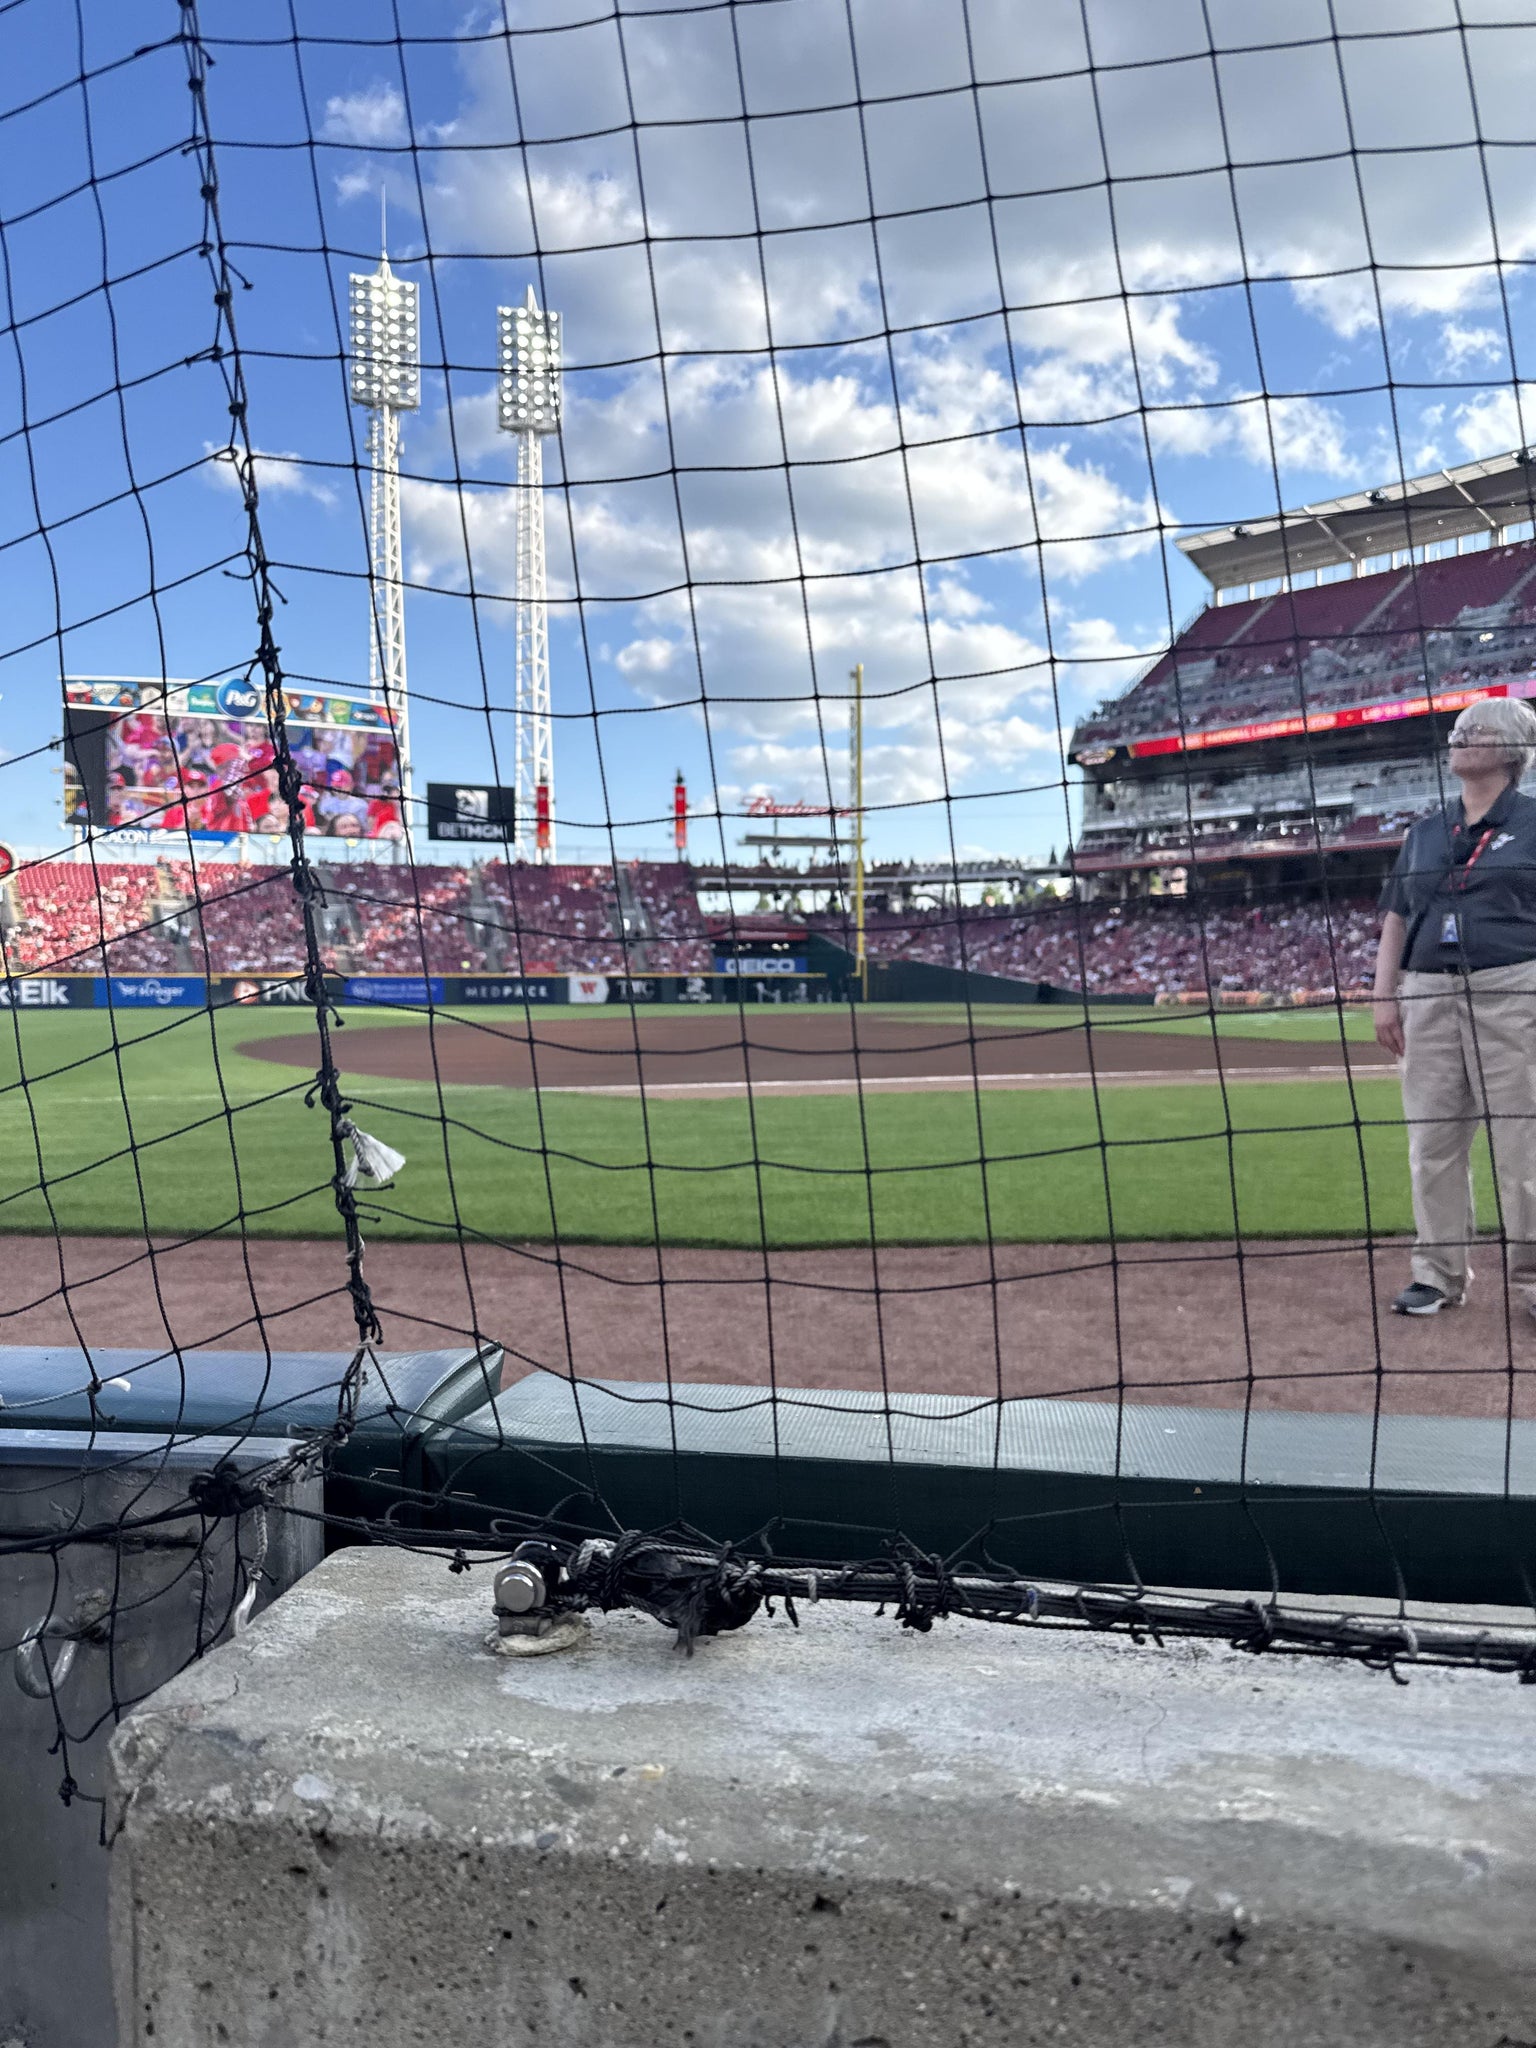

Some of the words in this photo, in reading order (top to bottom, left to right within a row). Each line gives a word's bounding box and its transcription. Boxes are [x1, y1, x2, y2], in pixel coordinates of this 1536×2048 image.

[225, 689, 257, 707] P&G
[437, 822, 508, 840] BETMGM
[725, 957, 796, 973] GEICO
[464, 984, 548, 998] MEDPACE
